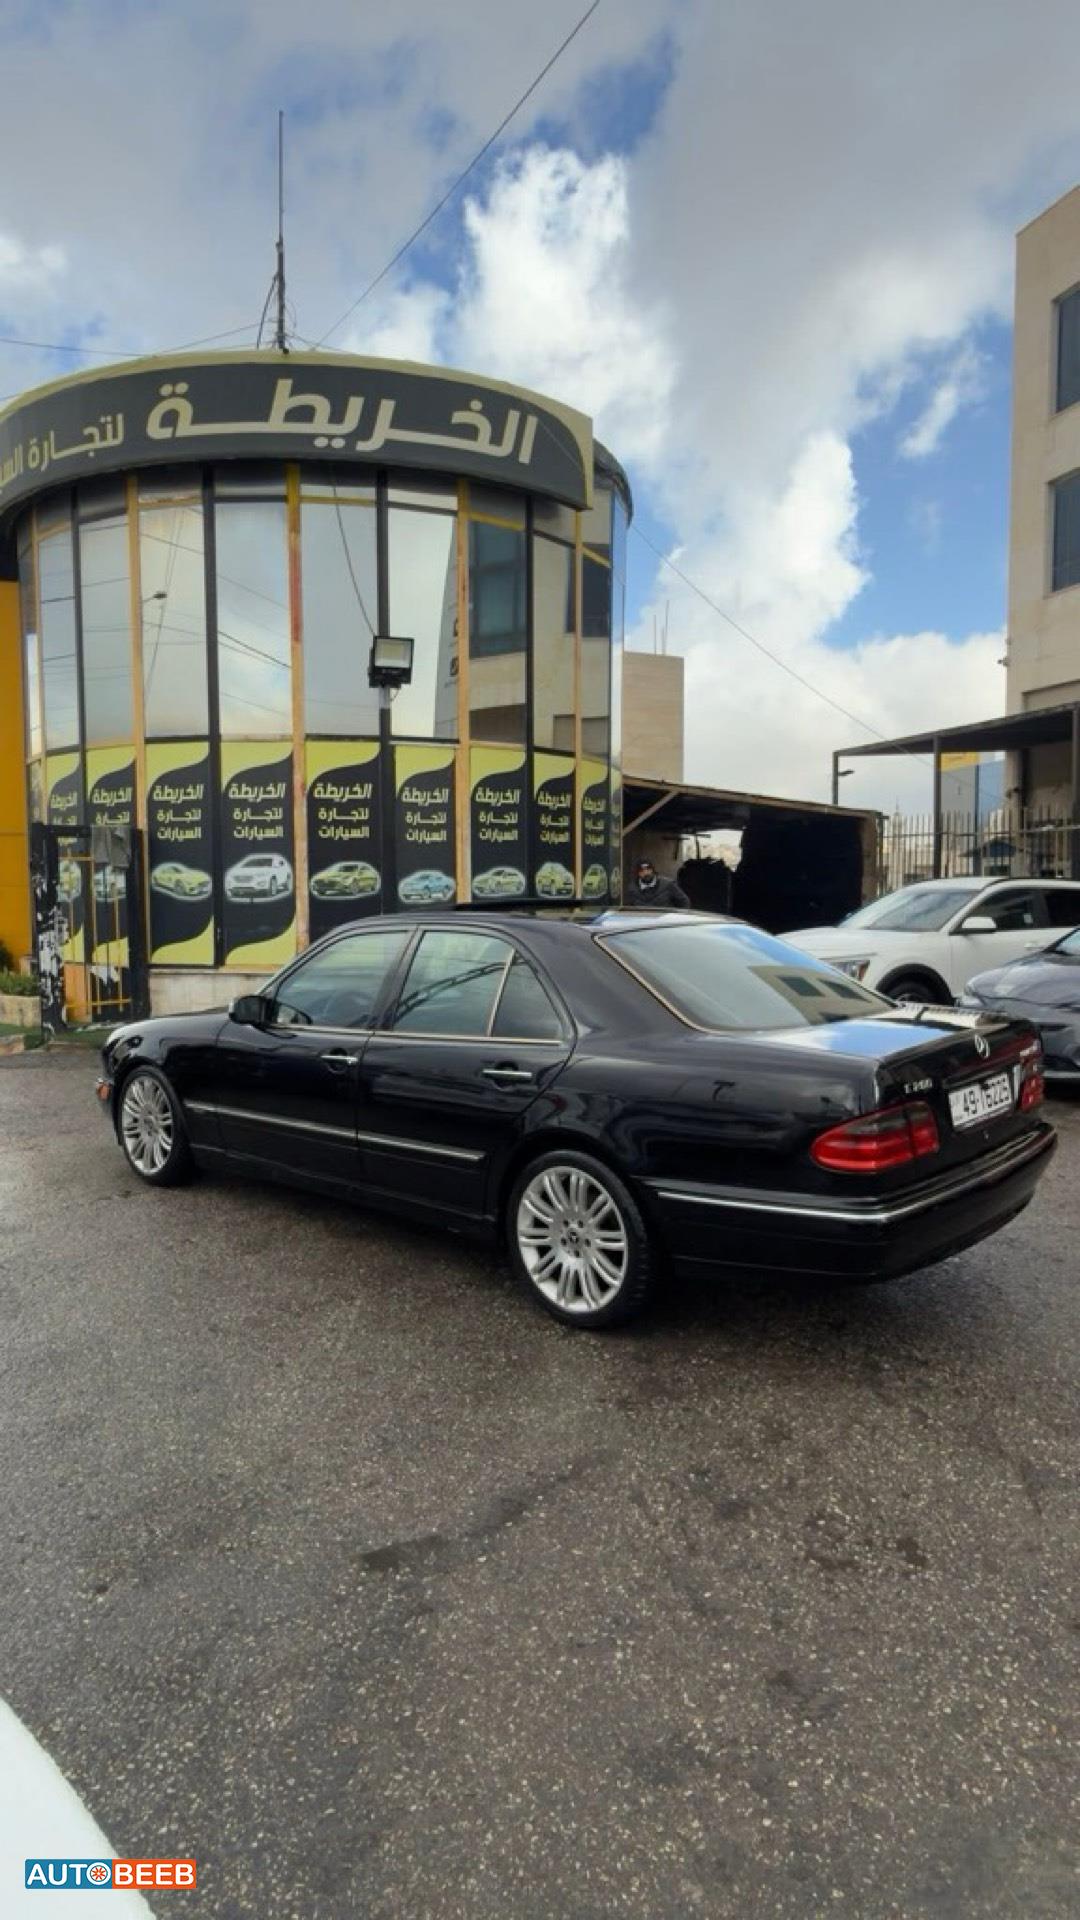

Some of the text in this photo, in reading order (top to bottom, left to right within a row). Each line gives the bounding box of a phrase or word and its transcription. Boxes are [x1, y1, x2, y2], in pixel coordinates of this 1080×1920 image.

[146, 378, 538, 464] الخريطة
[27, 412, 125, 473] لتجارة
[153, 783, 204, 804] الخريطة
[228, 783, 286, 803] الخريطة
[314, 782, 373, 803] الخريطة
[402, 787, 449, 806] الخريطة
[475, 787, 520, 807] الخريطة
[156, 809, 201, 823] لتجارة
[233, 808, 283, 822] لتجارة
[318, 808, 369, 822] لتجارة
[405, 812, 447, 825] لتجارة
[157, 827, 202, 842] السيارات
[233, 825, 284, 841] السيارات
[318, 826, 370, 841] السيارات
[406, 829, 447, 844] السيارات
